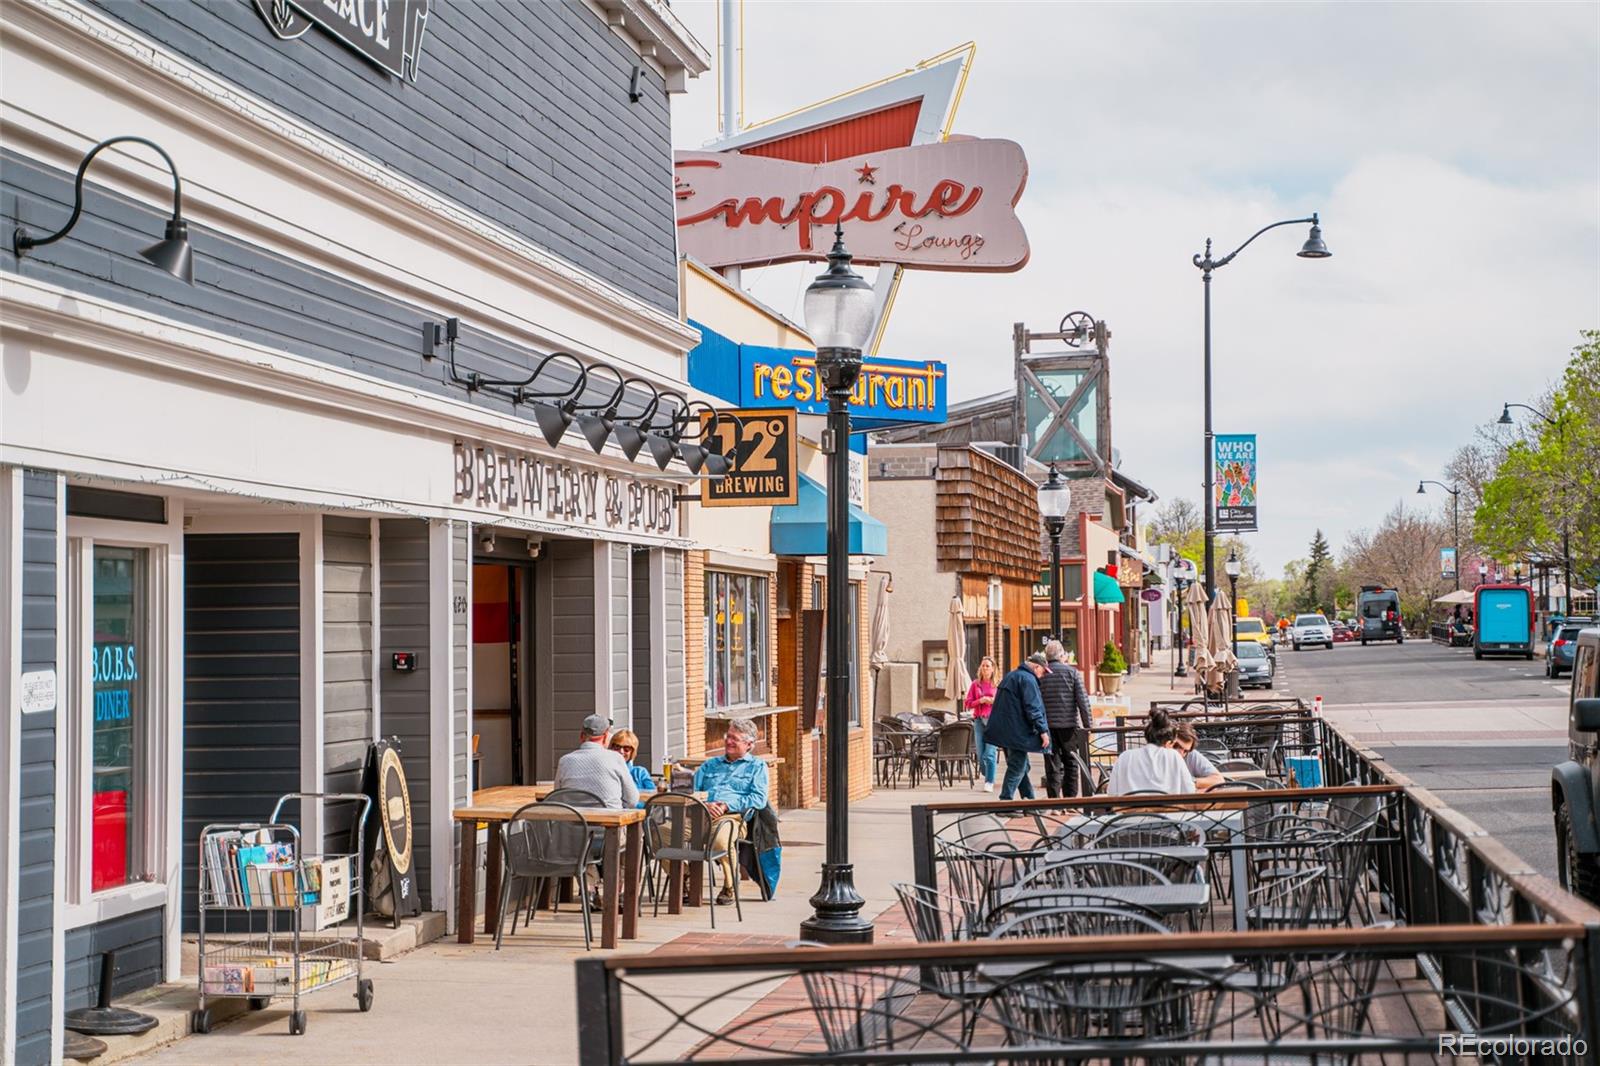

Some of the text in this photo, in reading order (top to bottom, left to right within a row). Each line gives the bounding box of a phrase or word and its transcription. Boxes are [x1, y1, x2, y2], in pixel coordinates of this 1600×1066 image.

[754, 356, 945, 411] resturant
[1217, 441, 1254, 453] WHO
[1217, 452, 1254, 460] WE ARE
[454, 440, 671, 533] BREWERY & PUB
[96, 689, 130, 721] DINER
